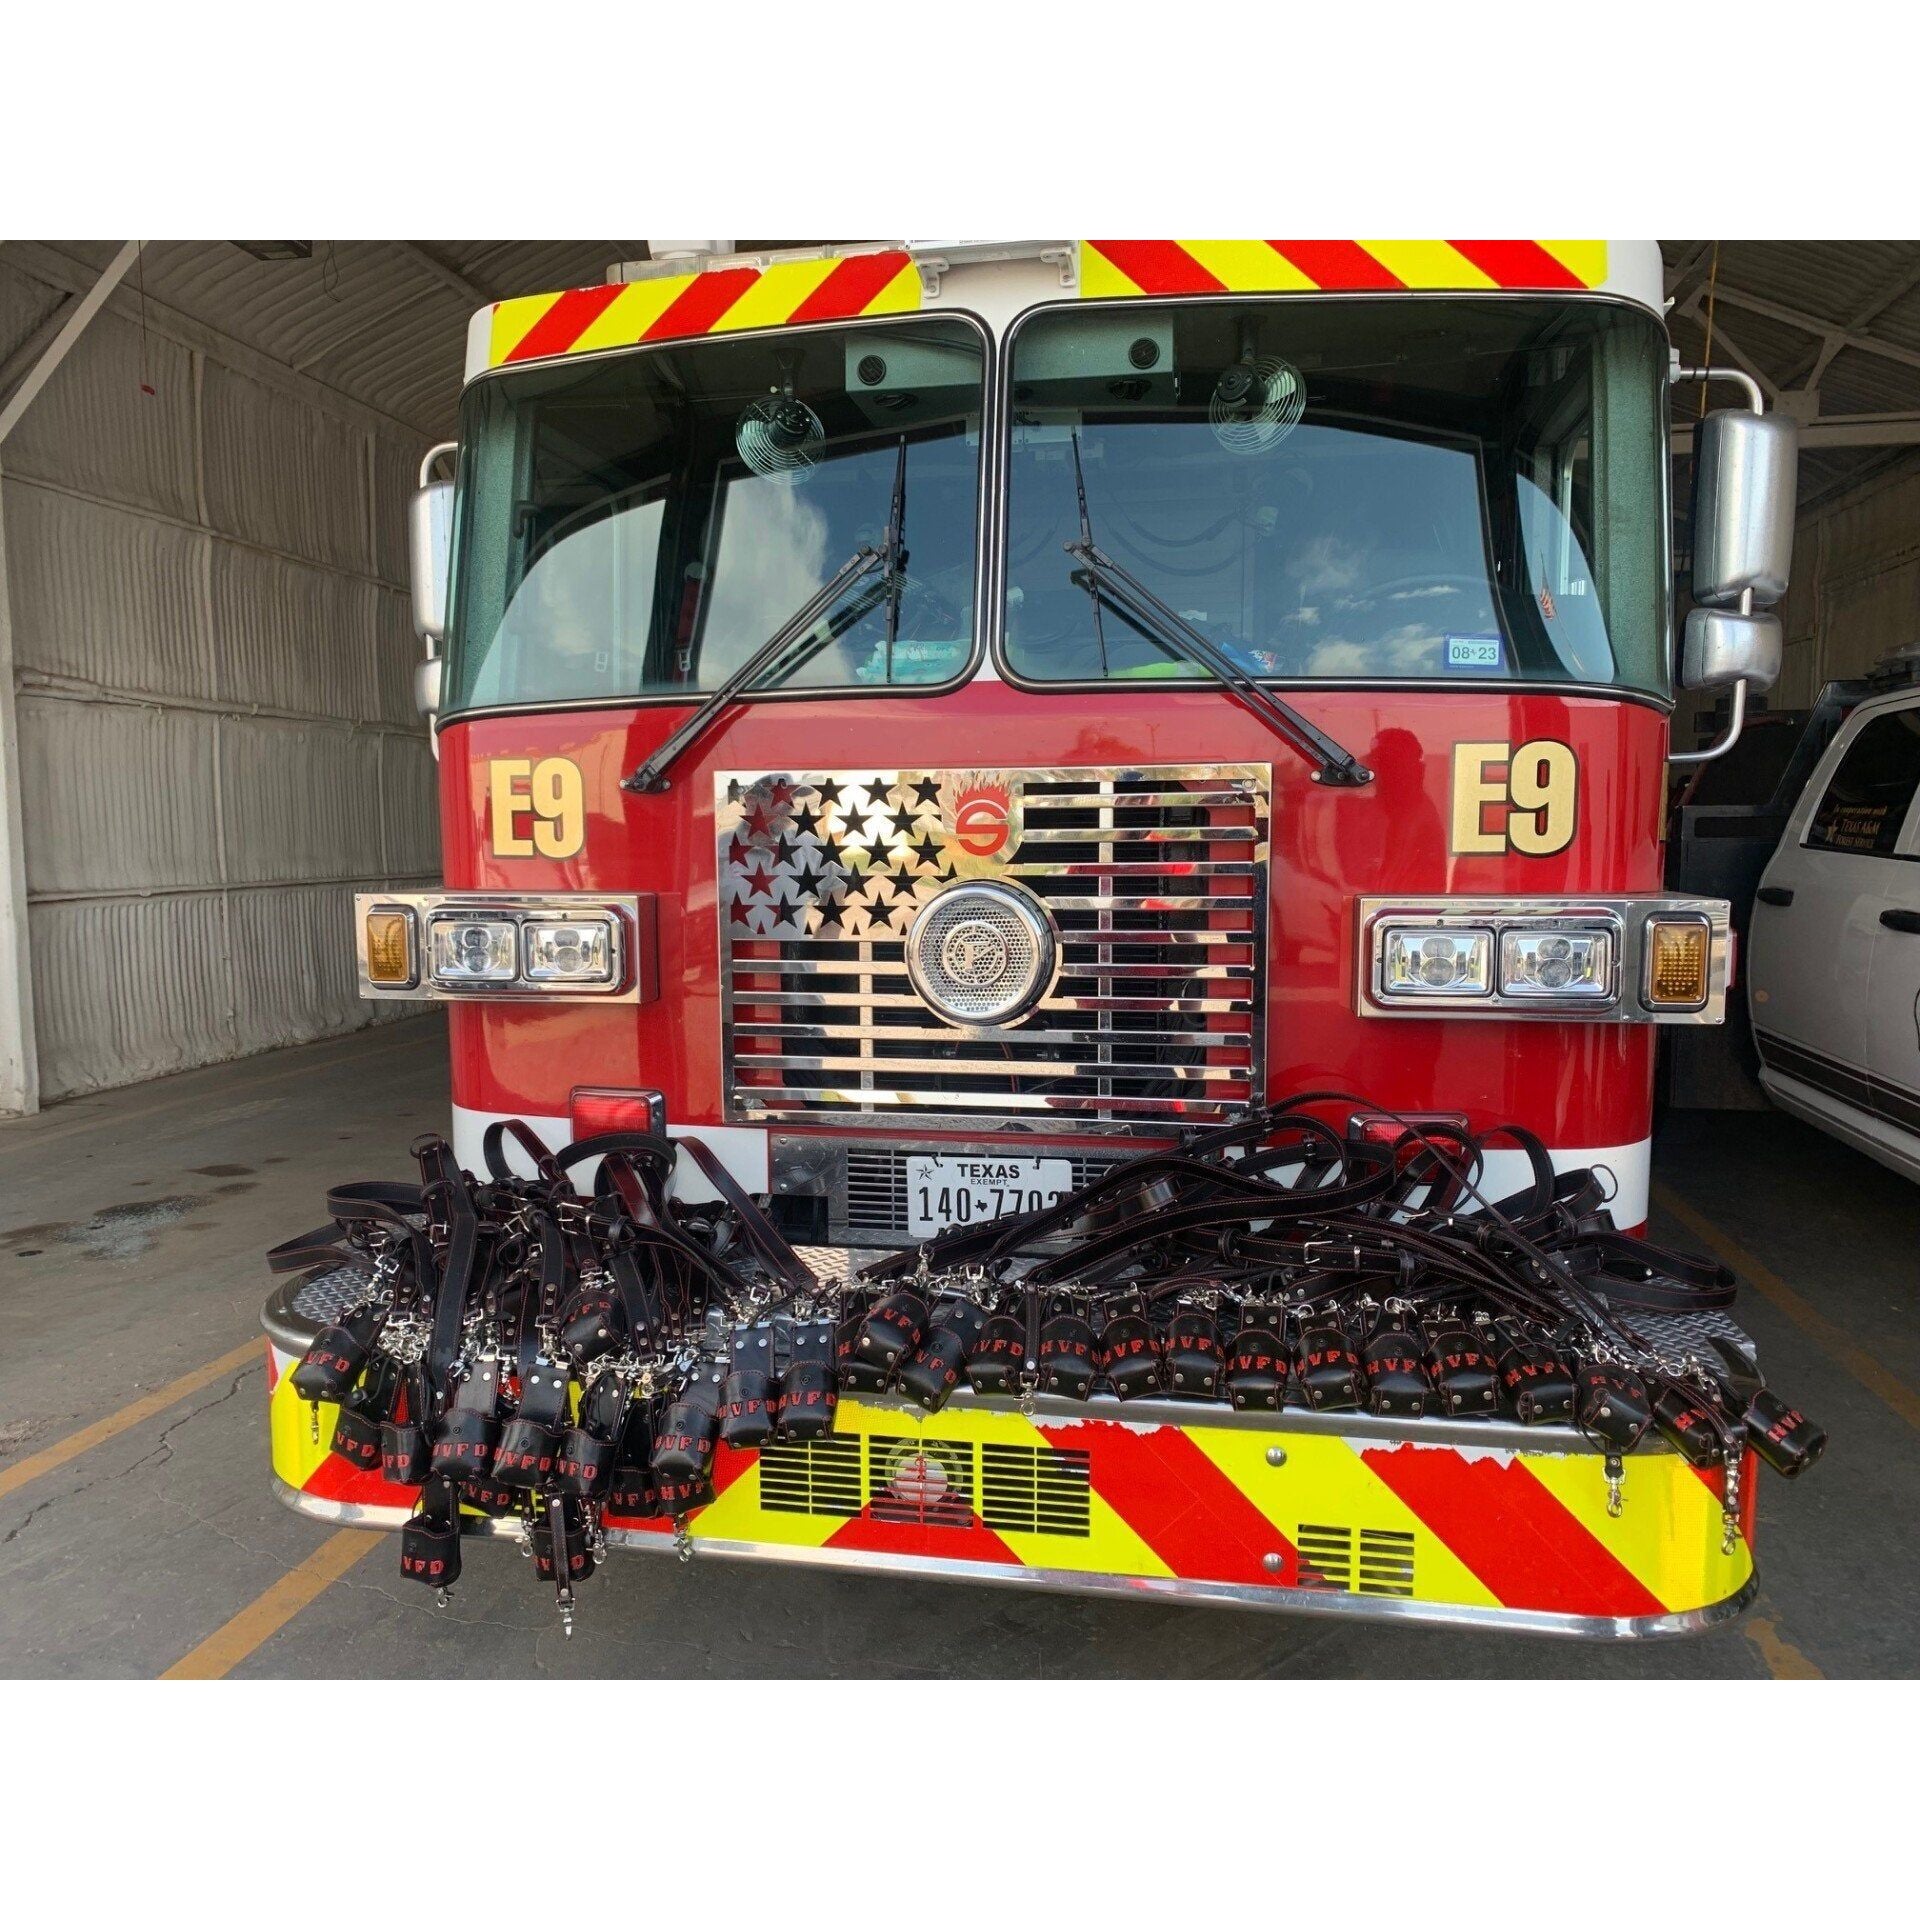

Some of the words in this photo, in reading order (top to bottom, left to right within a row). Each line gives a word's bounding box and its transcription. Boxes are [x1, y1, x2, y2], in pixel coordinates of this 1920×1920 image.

[1452, 646, 1470, 659] 08
[1478, 647, 1496, 660] 23
[489, 756, 584, 859] E9
[1450, 739, 1578, 858] E9
[957, 1164, 1020, 1178] TEXAS
[970, 1178, 1008, 1186] EXEMPT
[919, 1187, 971, 1222] 140
